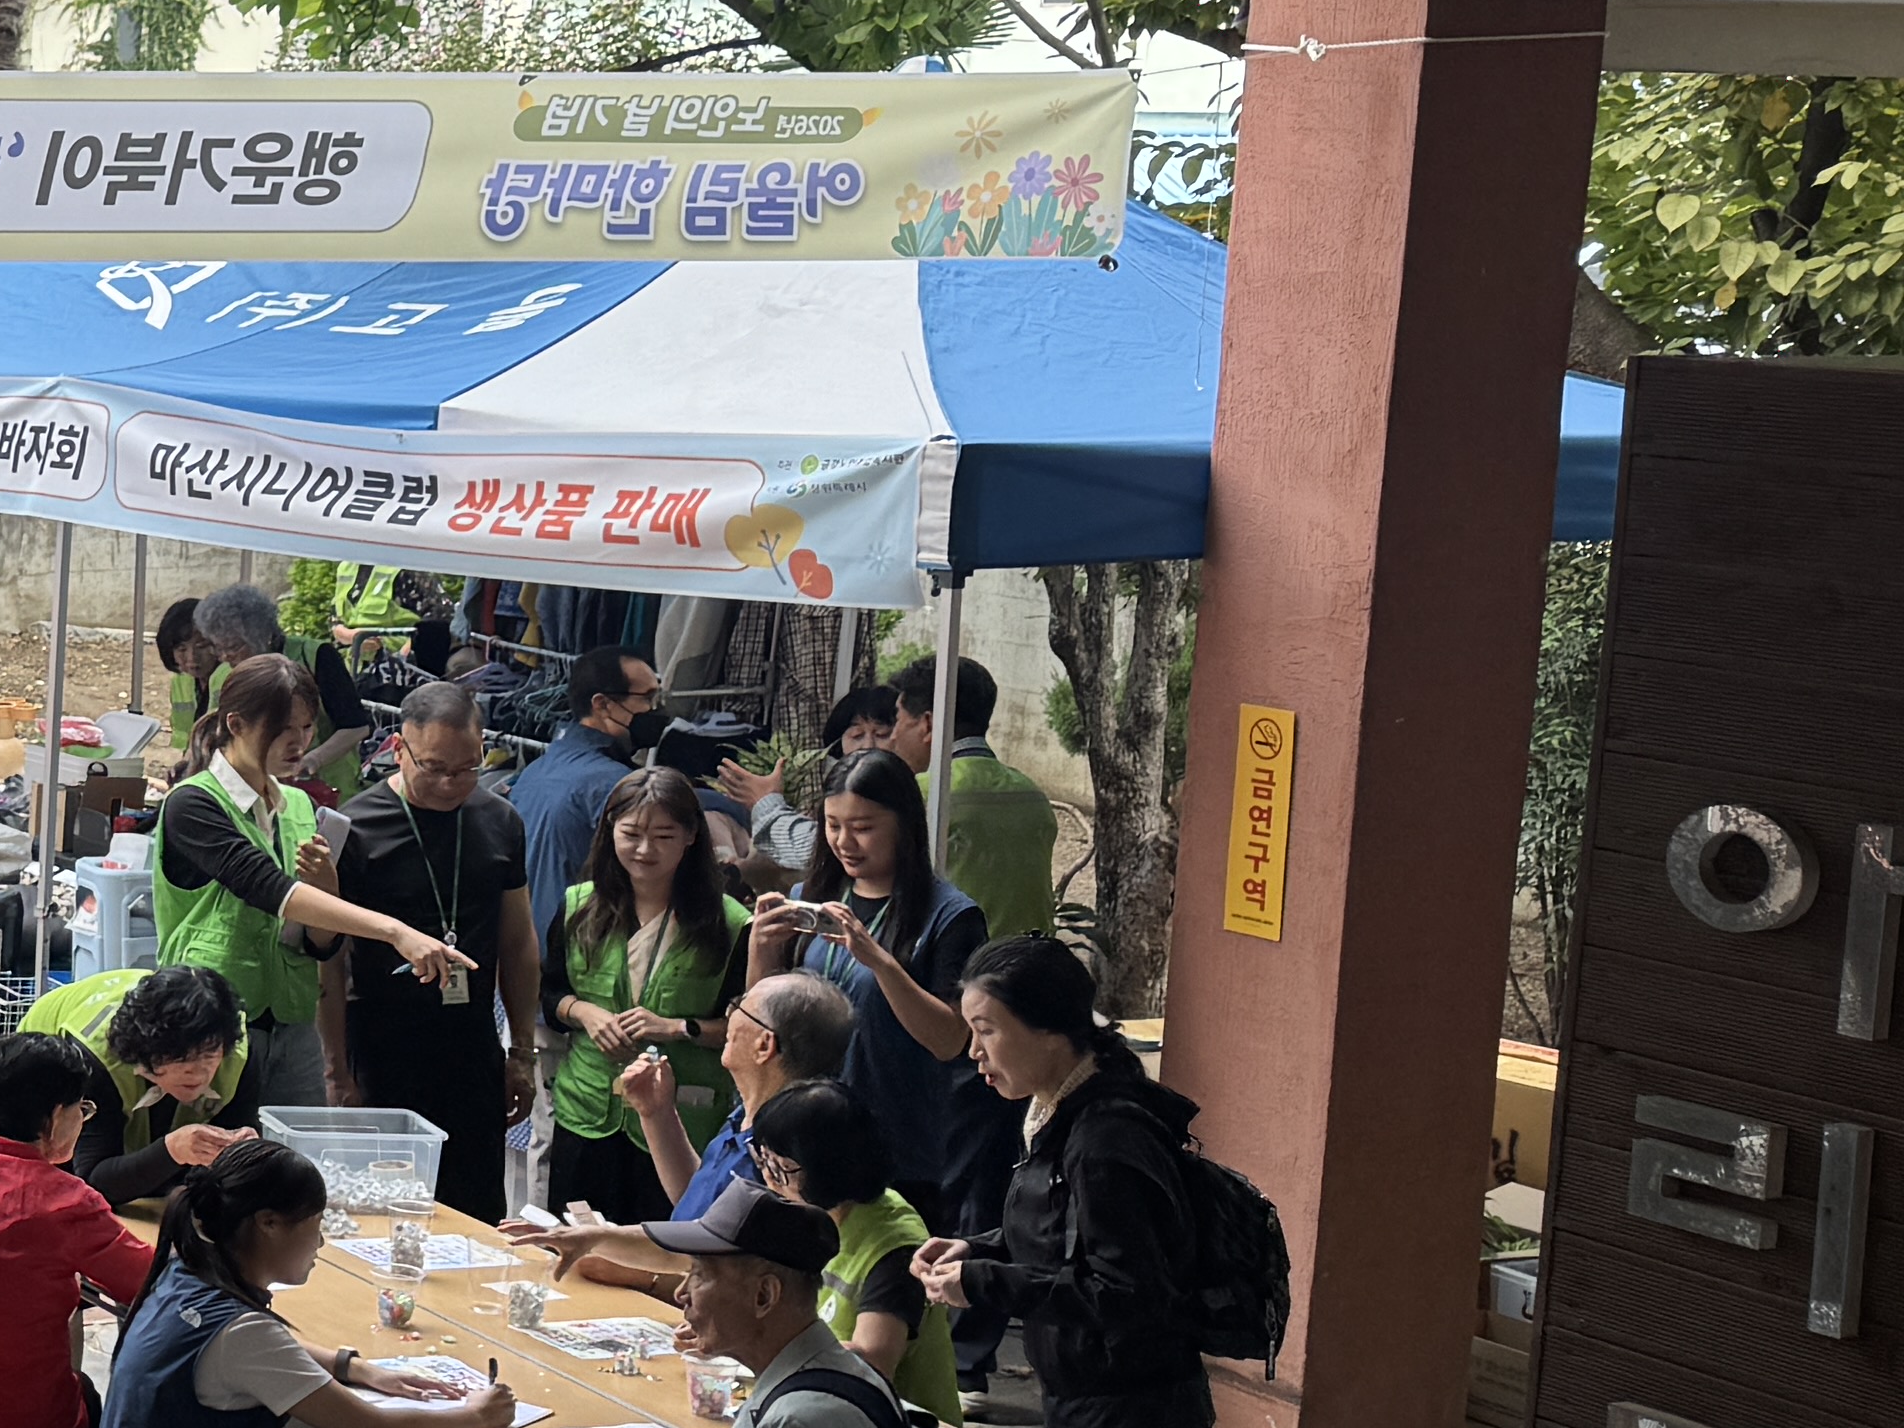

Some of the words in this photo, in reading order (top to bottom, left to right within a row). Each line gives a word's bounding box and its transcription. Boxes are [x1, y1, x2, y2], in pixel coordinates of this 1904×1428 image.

[148, 441, 440, 527] 마산시니어클럽
[445, 477, 595, 542] 생산품
[602, 486, 702, 549] 판매
[1243, 766, 1277, 913] 금연구역
